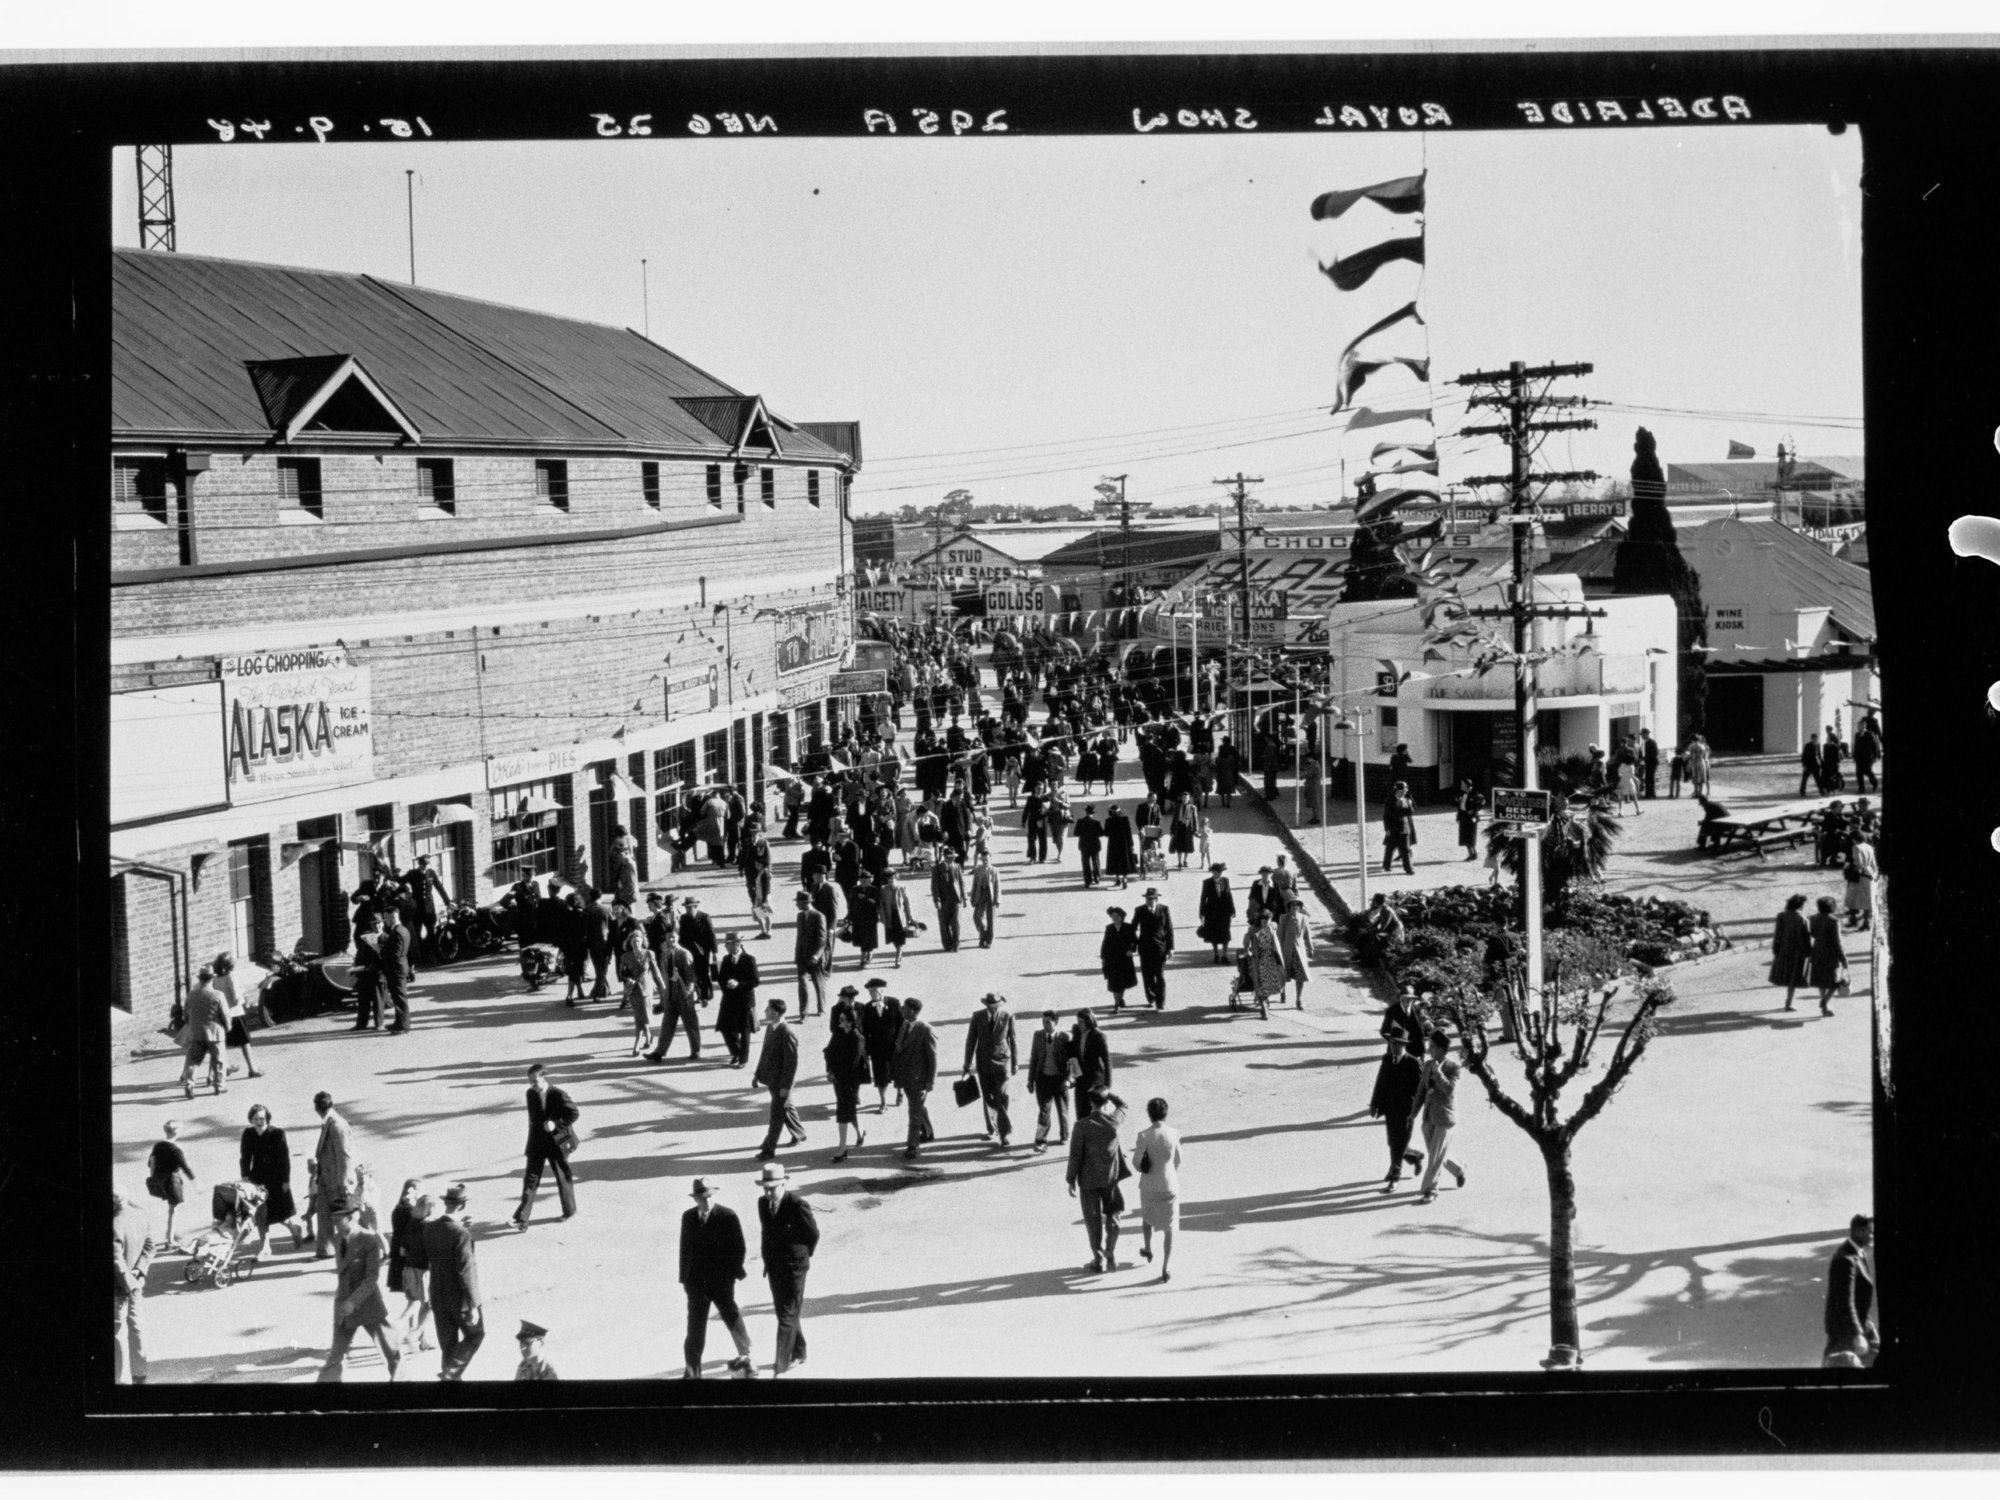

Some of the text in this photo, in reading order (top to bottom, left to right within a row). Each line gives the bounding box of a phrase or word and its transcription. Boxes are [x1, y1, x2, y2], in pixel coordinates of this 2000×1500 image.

[1572, 502, 1624, 516] BERRY'S
[949, 550, 983, 563] STUD
[969, 566, 1011, 581] SALES
[988, 592, 1044, 611] GOLDSB
[1233, 607, 1274, 618] CEAM
[1716, 609, 1743, 618] WINE
[1251, 621, 1276, 633] ONS
[1715, 620, 1745, 630] KIOSK
[237, 656, 262, 677] LOG
[266, 651, 325, 673] CHOPPING
[340, 706, 358, 720] ICE
[333, 722, 369, 739] CREAM
[228, 698, 335, 781] ALASKA
[548, 750, 577, 772] PIES
[1499, 813, 1541, 821] LOUNGE
